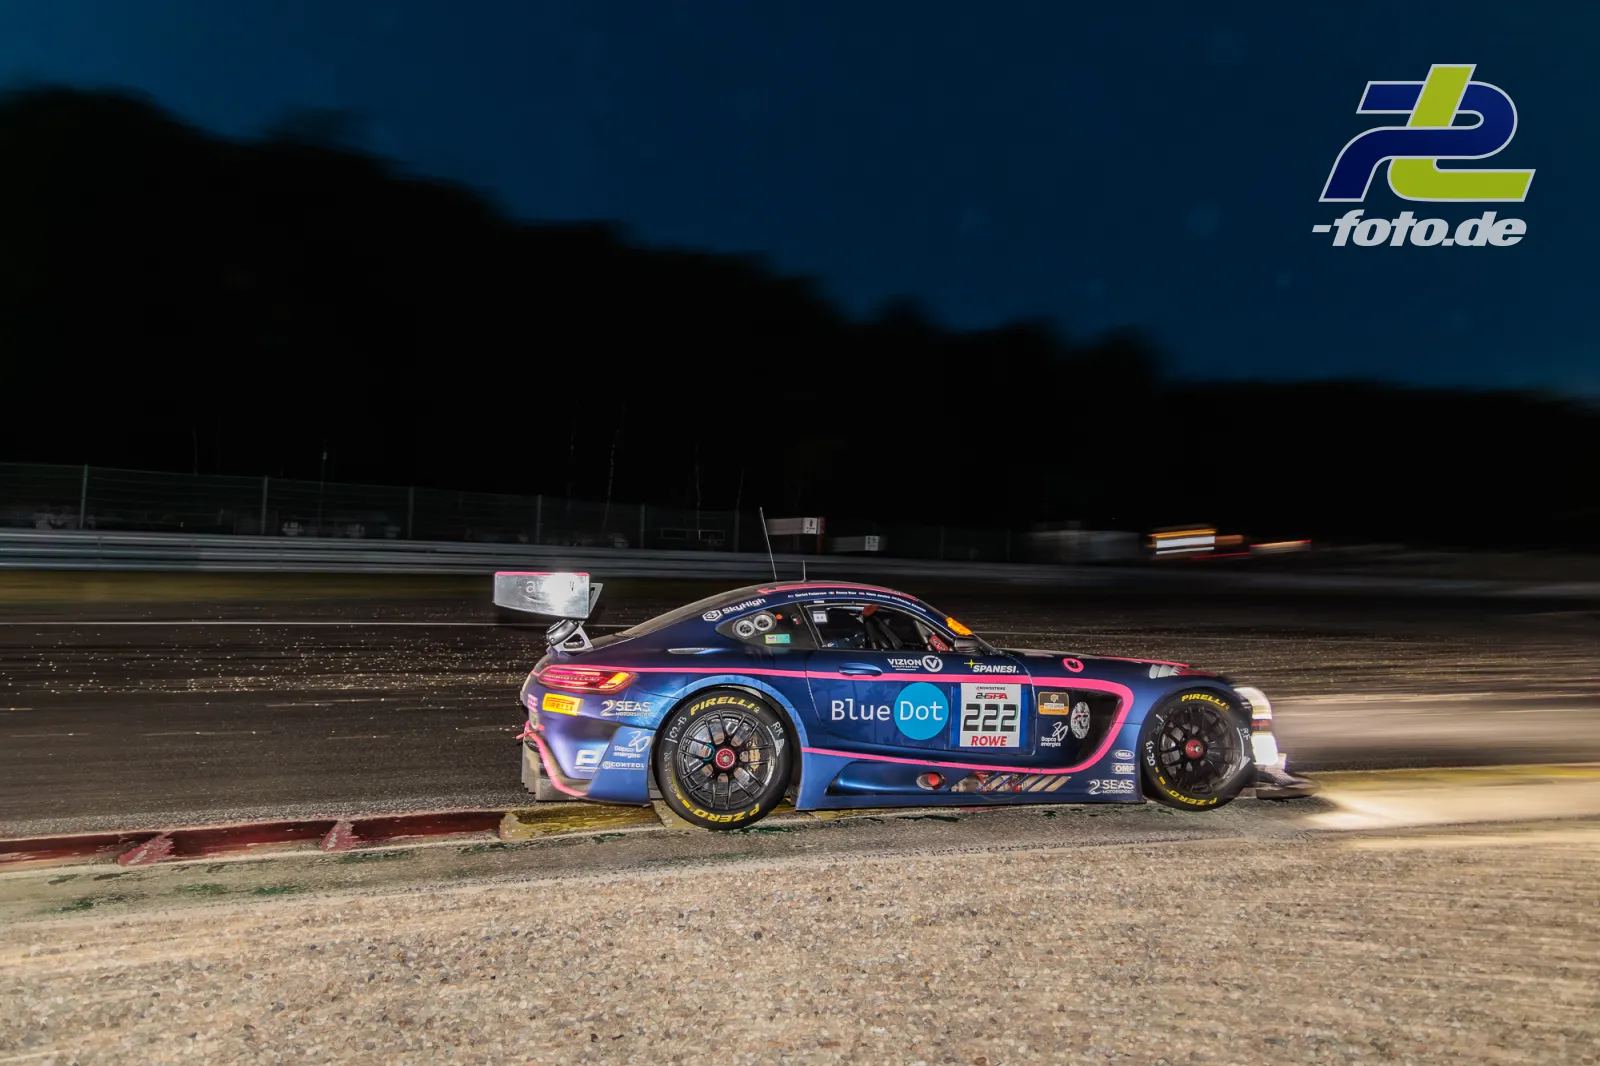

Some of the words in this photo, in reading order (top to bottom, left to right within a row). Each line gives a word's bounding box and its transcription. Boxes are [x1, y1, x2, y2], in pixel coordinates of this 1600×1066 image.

[722, 598, 766, 614] SkyHigh
[887, 658, 922, 667] VIZION
[616, 701, 651, 711] SEAS
[690, 697, 754, 716] PIRELLI
[1181, 693, 1226, 708] PIRELLI
[831, 699, 891, 721] Blue
[900, 701, 943, 721] Dot
[963, 703, 1019, 732] 222
[971, 736, 1007, 746] ROWE
[1102, 780, 1135, 789] SEAS
